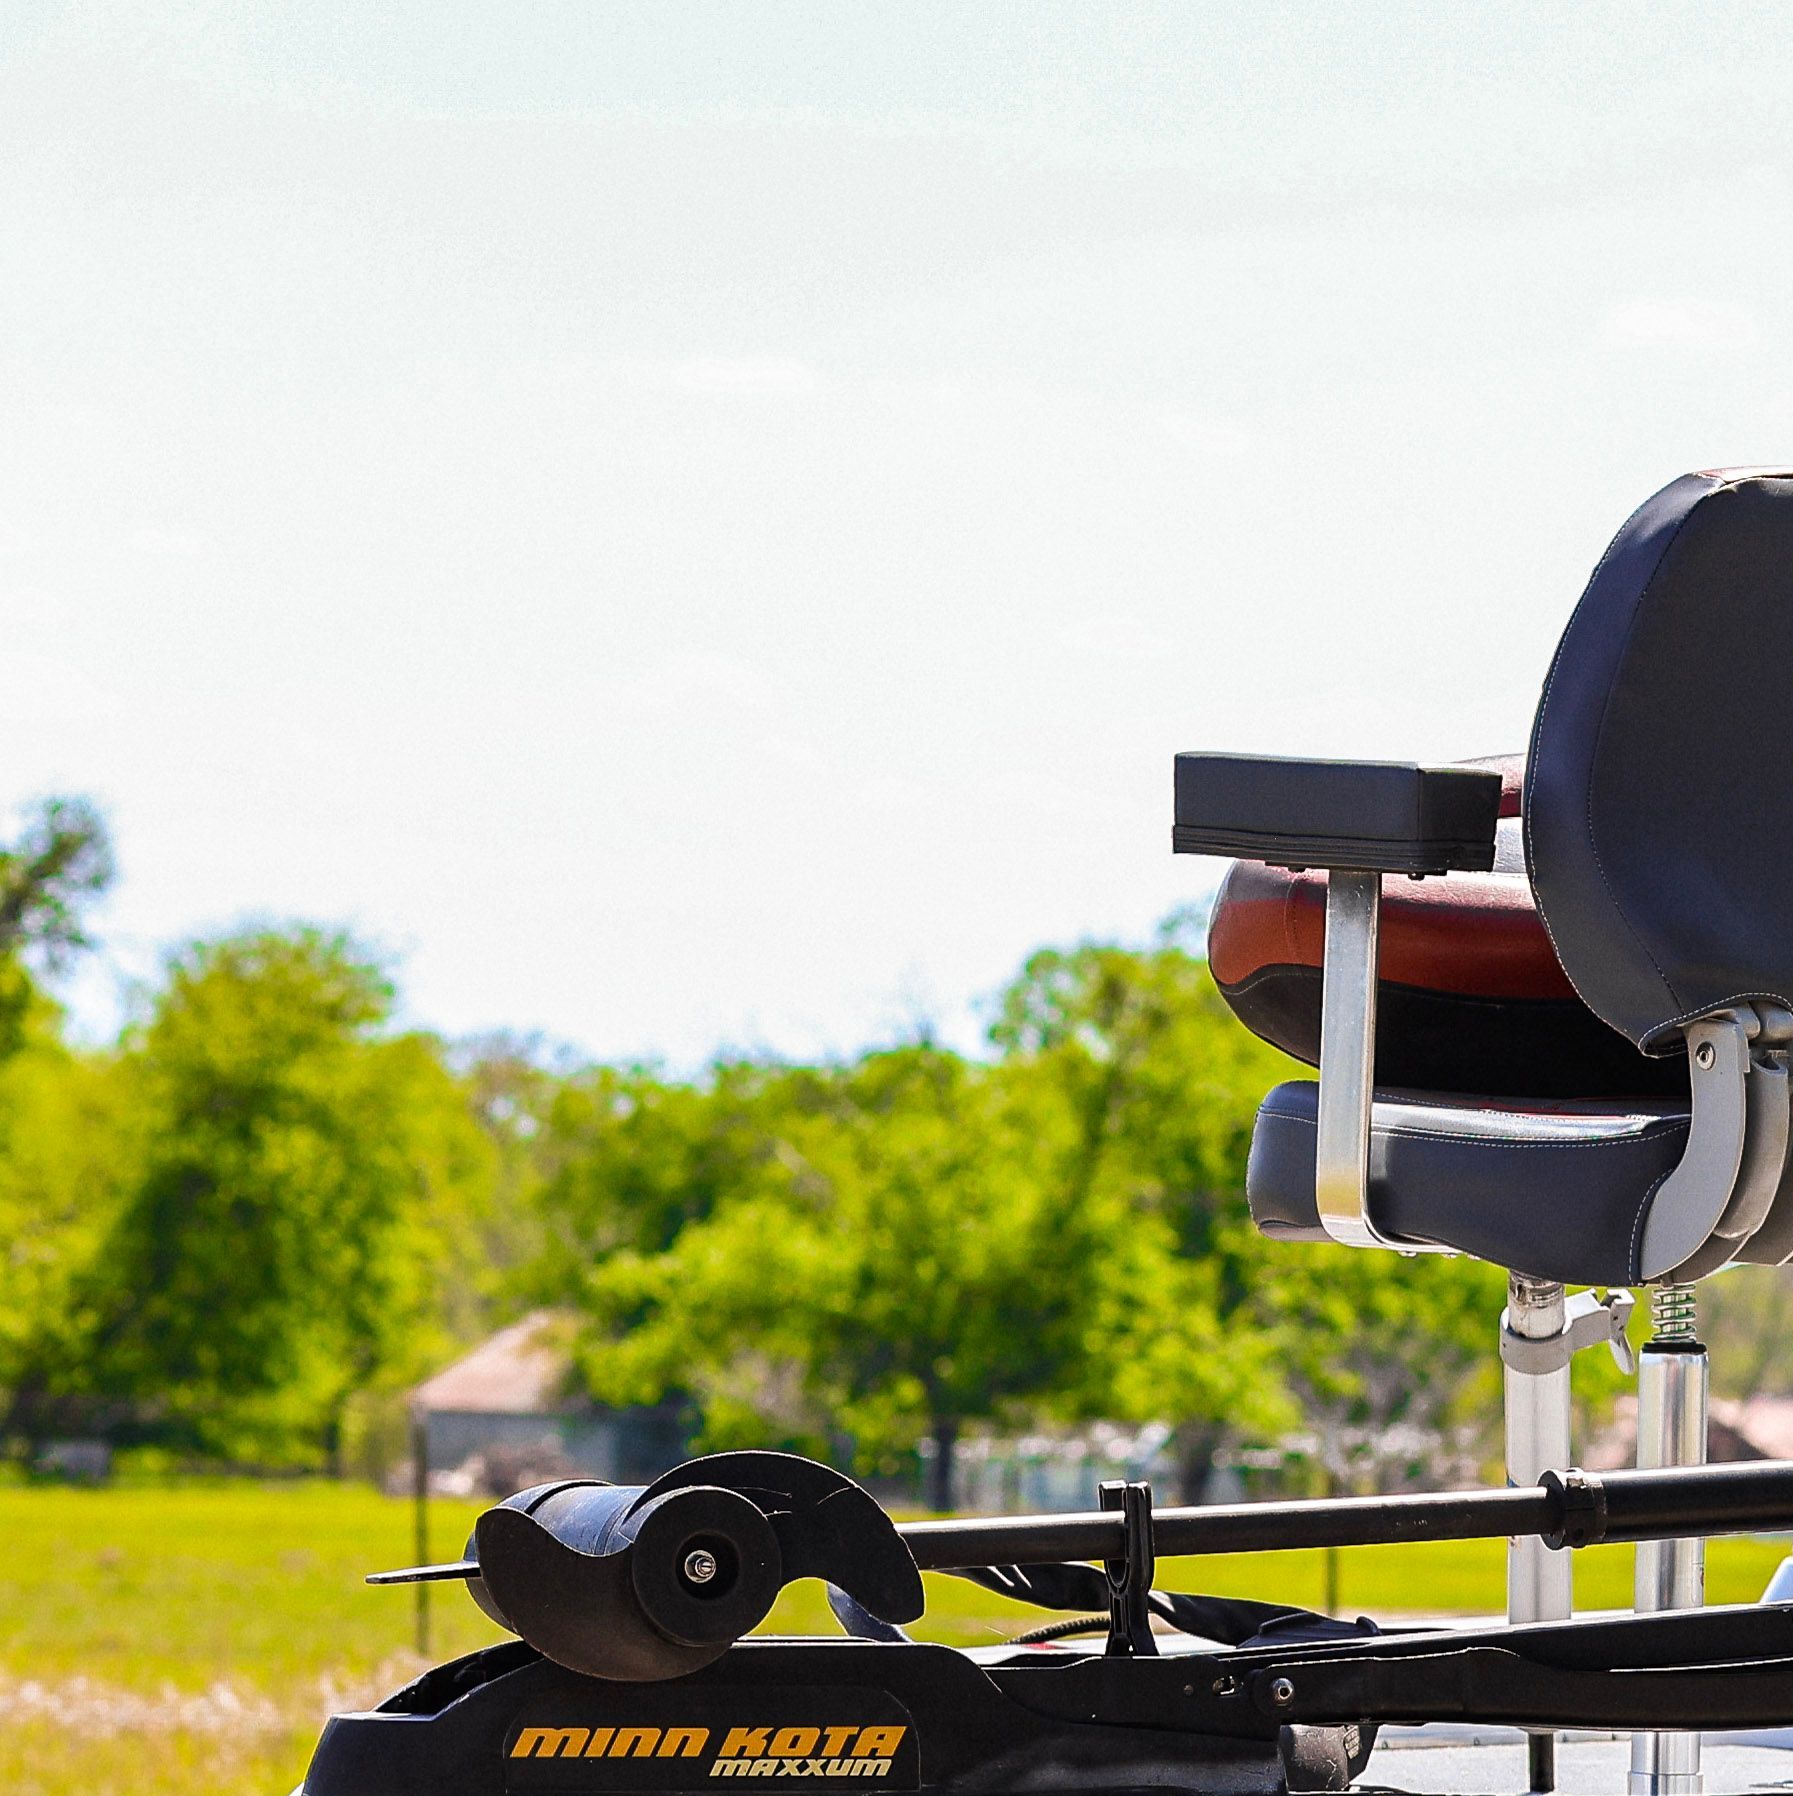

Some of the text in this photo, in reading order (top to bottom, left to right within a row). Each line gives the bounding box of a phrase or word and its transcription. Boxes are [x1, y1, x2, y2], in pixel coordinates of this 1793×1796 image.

[510, 1725, 908, 1758] MINN KOTA
[709, 1758, 893, 1777] MAXXUM
